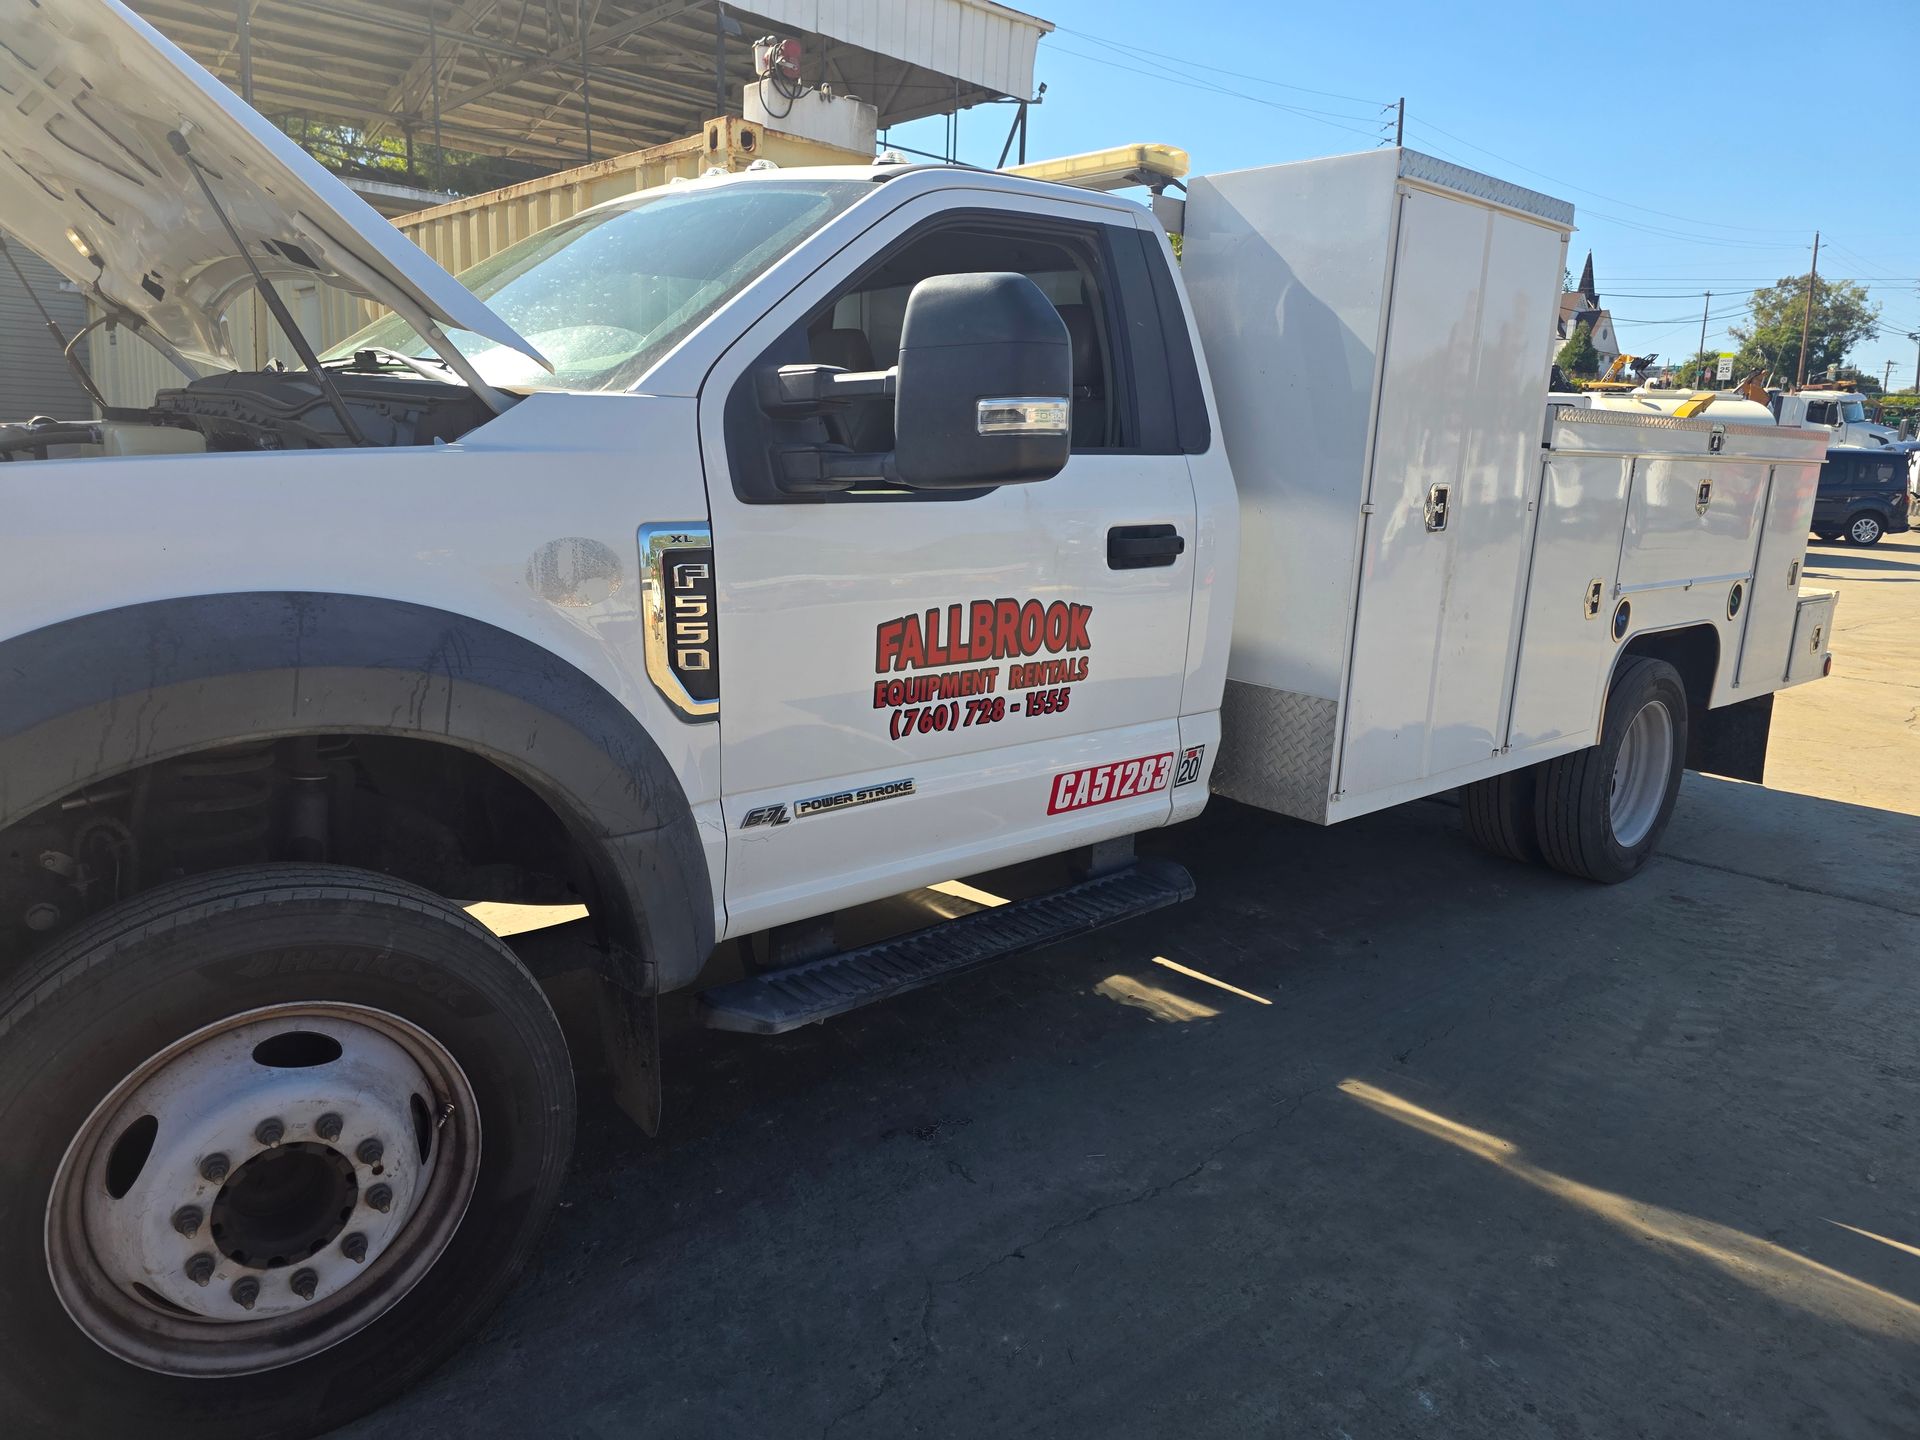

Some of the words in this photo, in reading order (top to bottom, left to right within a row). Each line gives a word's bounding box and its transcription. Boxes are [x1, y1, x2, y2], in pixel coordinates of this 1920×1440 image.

[670, 534, 693, 543] XL
[875, 598, 1093, 674] FALLBROOK
[873, 667, 999, 708] EQUIPMENT
[1008, 656, 1089, 690] RENTALS
[889, 706, 960, 741] (760)
[962, 696, 1005, 727] 728
[1025, 688, 1071, 718] 1555
[1053, 755, 1173, 811] CA51283
[1177, 757, 1199, 784] 20
[800, 793, 854, 813] POWER
[856, 781, 913, 802] STROKE
